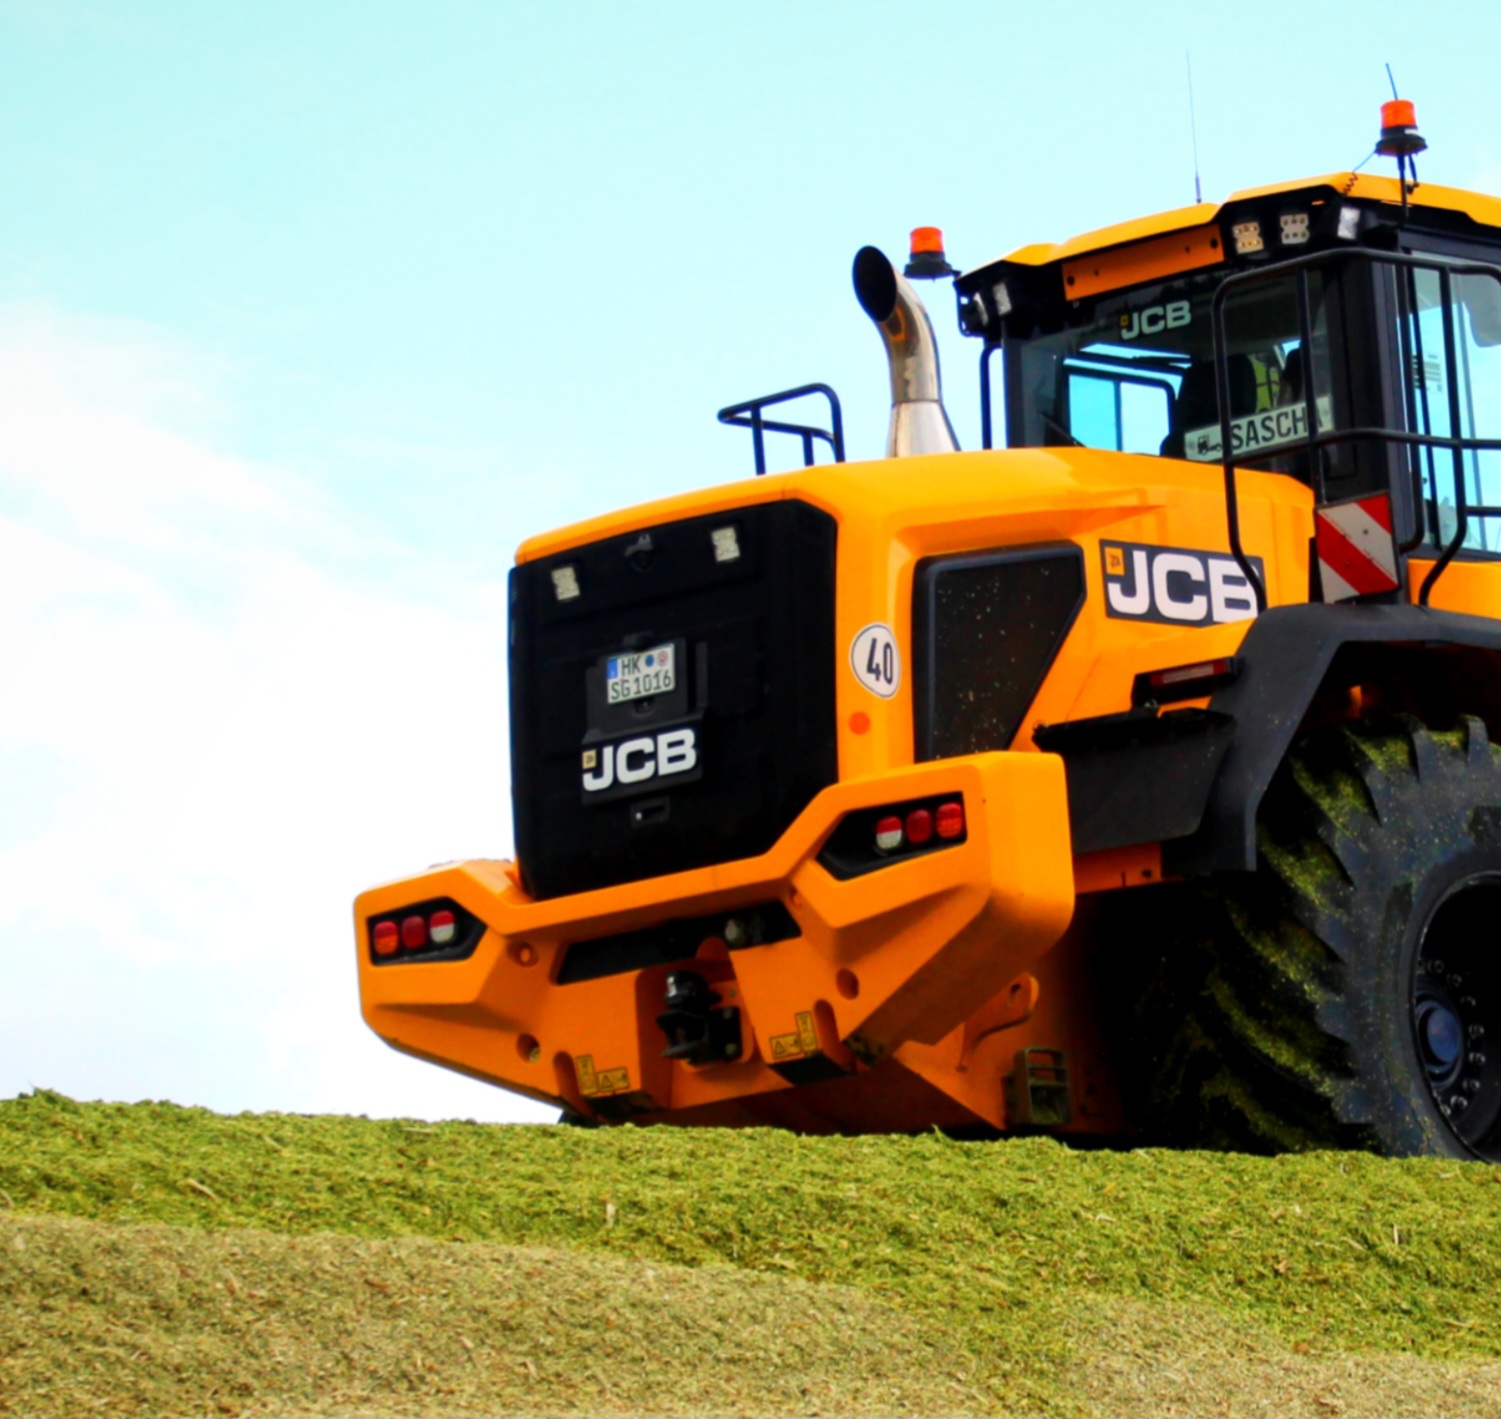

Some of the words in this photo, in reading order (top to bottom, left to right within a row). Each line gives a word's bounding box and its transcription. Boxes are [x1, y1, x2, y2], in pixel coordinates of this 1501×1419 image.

[1121, 300, 1192, 340] JCB
[1231, 402, 1323, 450] SASCH
[1107, 550, 1259, 624] JCB
[621, 655, 641, 676] HK
[866, 637, 893, 685] 40
[582, 728, 697, 792] JCB
